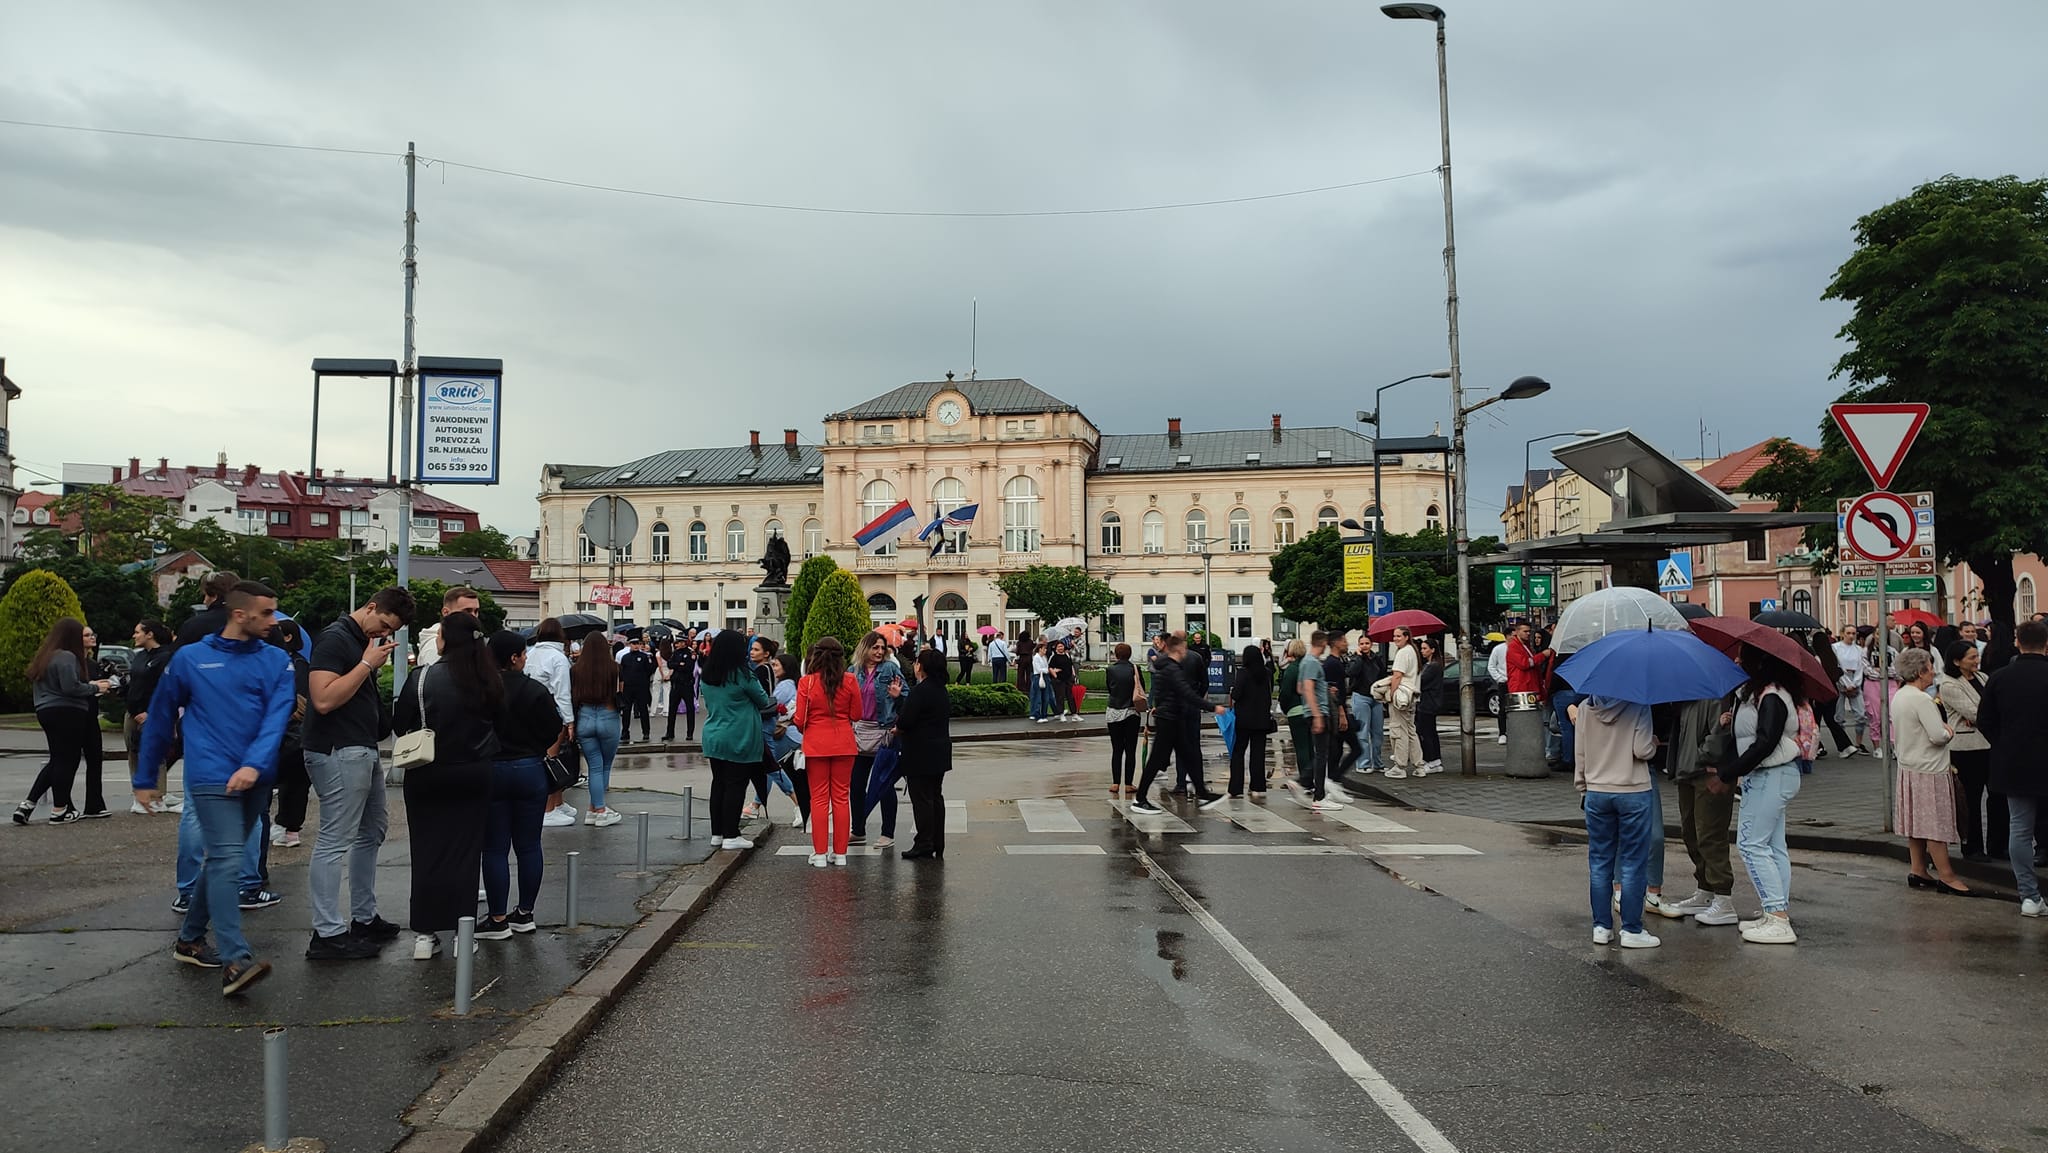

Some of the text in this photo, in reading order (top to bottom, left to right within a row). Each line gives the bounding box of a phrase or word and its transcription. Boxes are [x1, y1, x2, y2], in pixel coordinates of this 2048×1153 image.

[430, 416, 488, 424] SVAKODNEVNI
[435, 426, 483, 434] AUTOBUSKI
[435, 436, 468, 444] PREVOZ
[443, 446, 488, 454] NJEMAČKU
[427, 462, 488, 471] 065 539 920
[1347, 545, 1371, 554] LUIS
[1373, 595, 1388, 613] P
